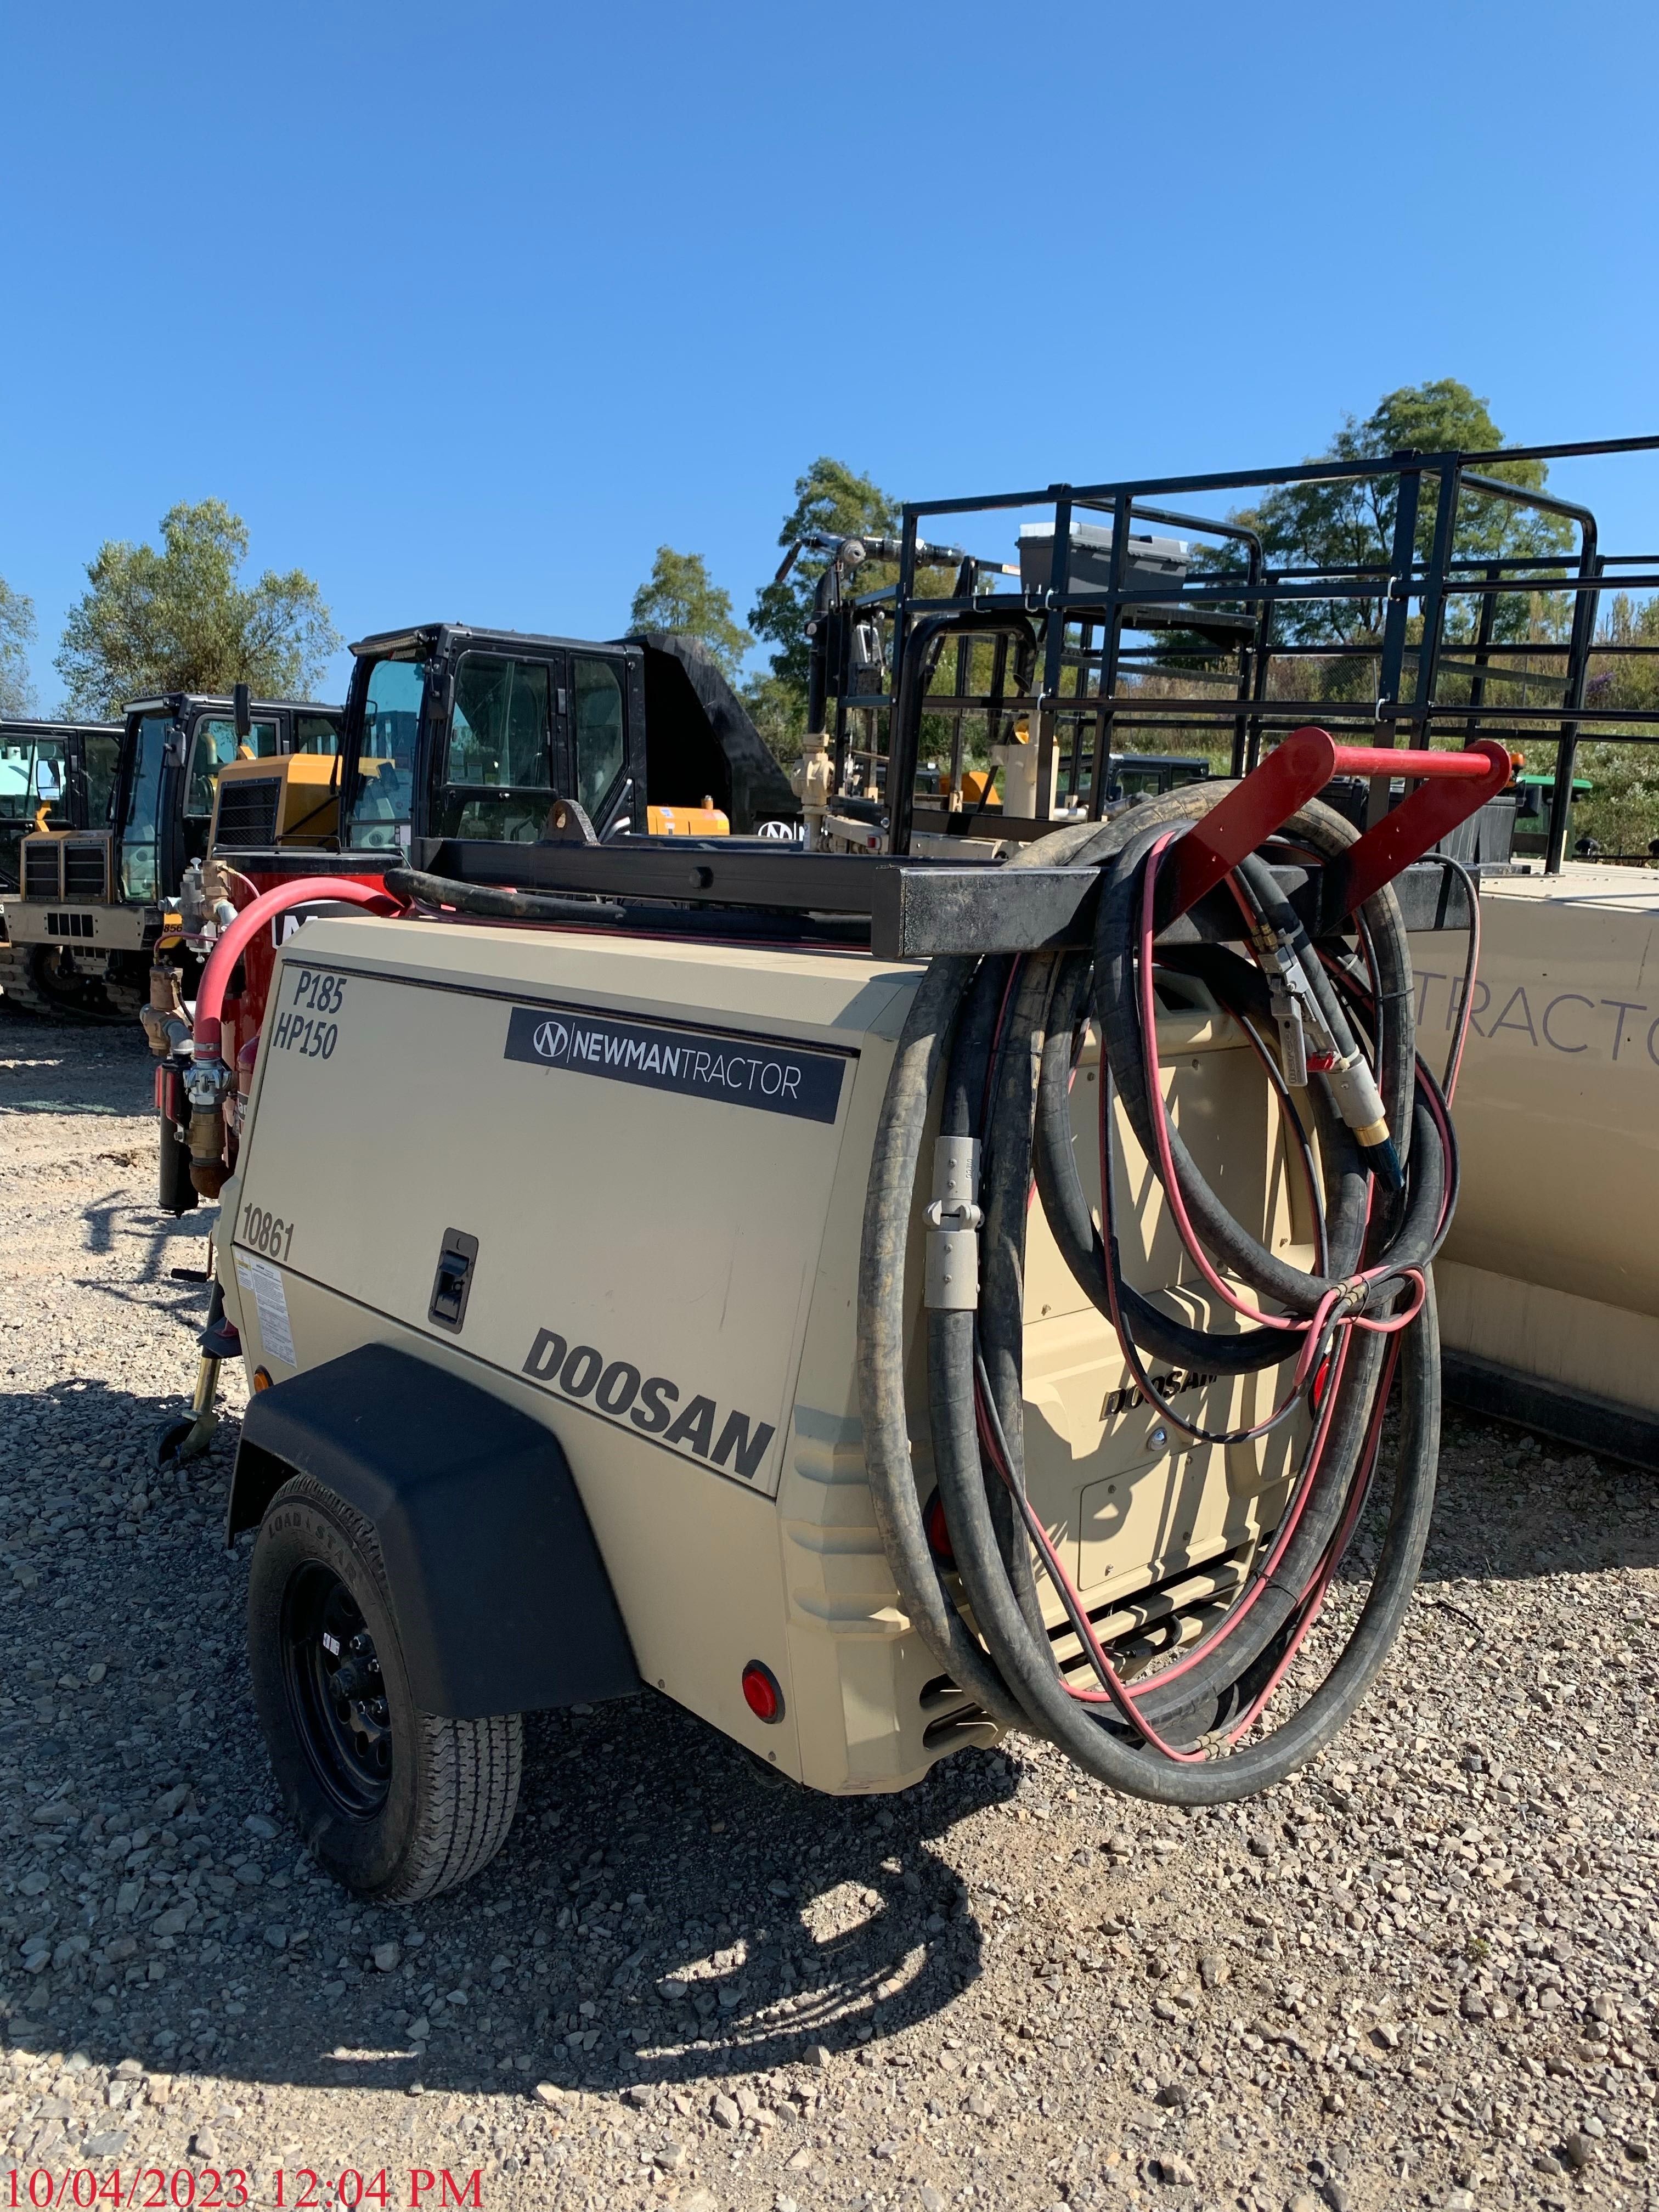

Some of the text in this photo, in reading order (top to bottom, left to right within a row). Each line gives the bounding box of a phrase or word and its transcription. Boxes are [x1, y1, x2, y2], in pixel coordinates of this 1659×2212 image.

[293, 970, 347, 1014] P185
[1413, 970, 1659, 1067] TRACT
[273, 1012, 338, 1059] HP150
[242, 1203, 294, 1262] 10861
[522, 1327, 776, 1480] DOOSAN
